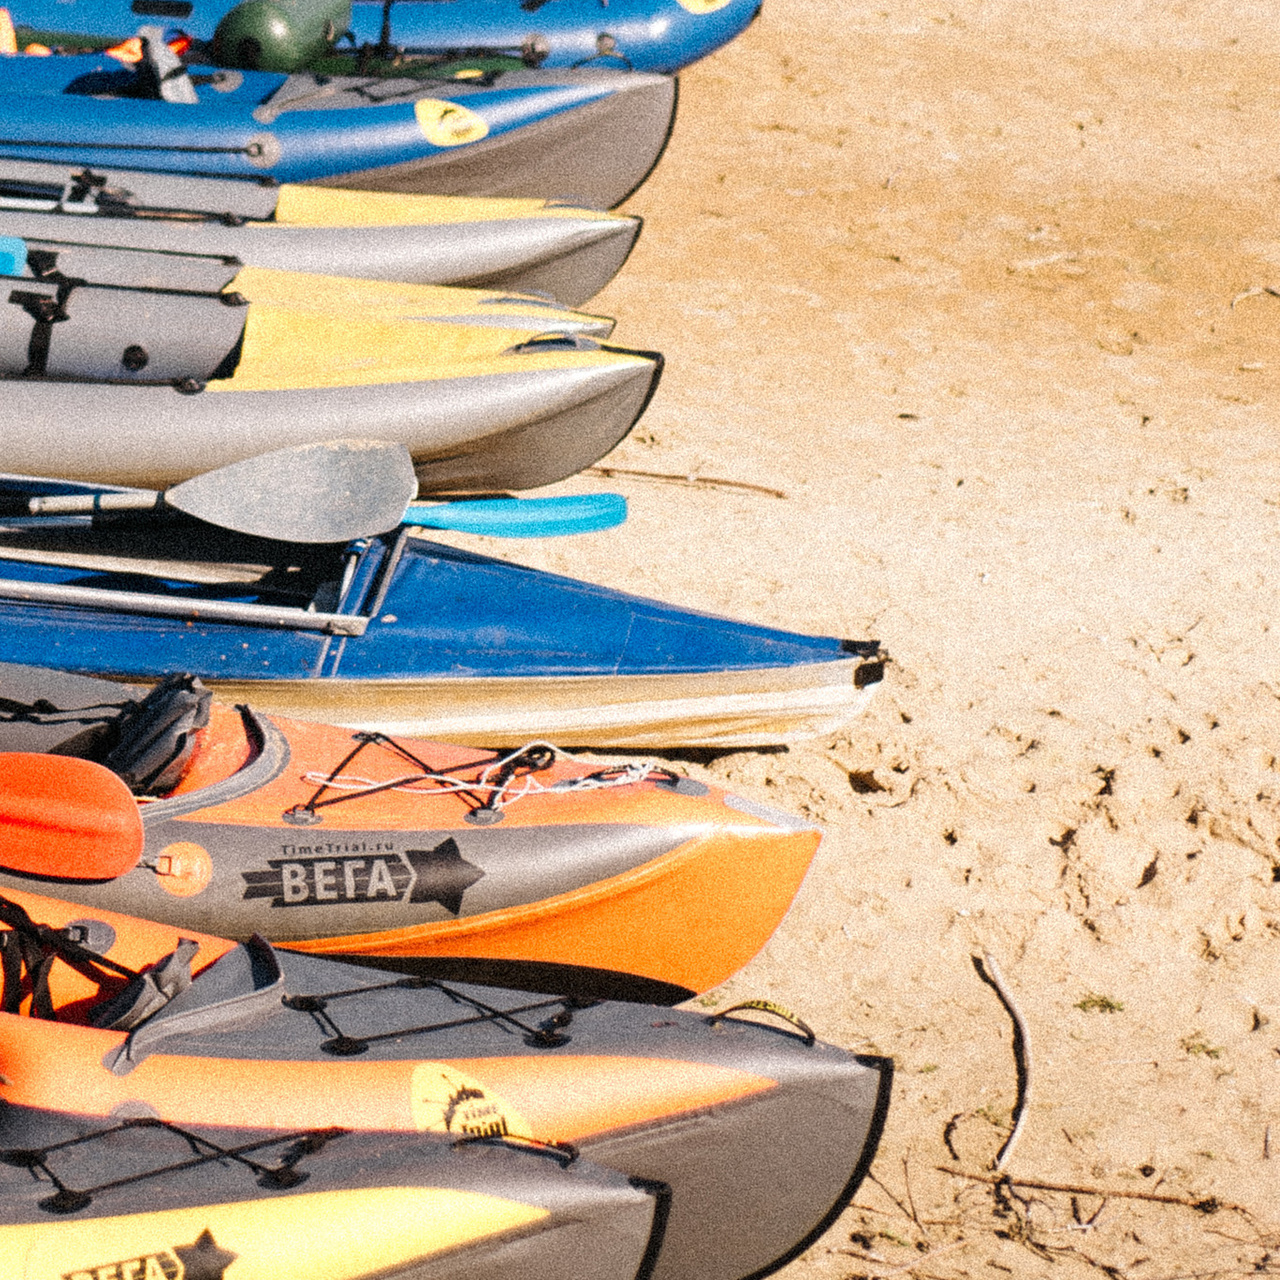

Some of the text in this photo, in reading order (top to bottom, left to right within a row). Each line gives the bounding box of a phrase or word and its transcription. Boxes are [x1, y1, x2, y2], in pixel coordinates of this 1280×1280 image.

[282, 842, 394, 856] TimeTrial.ru
[282, 859, 398, 902] ВЕГА
[70, 1256, 168, 1280] ГА
